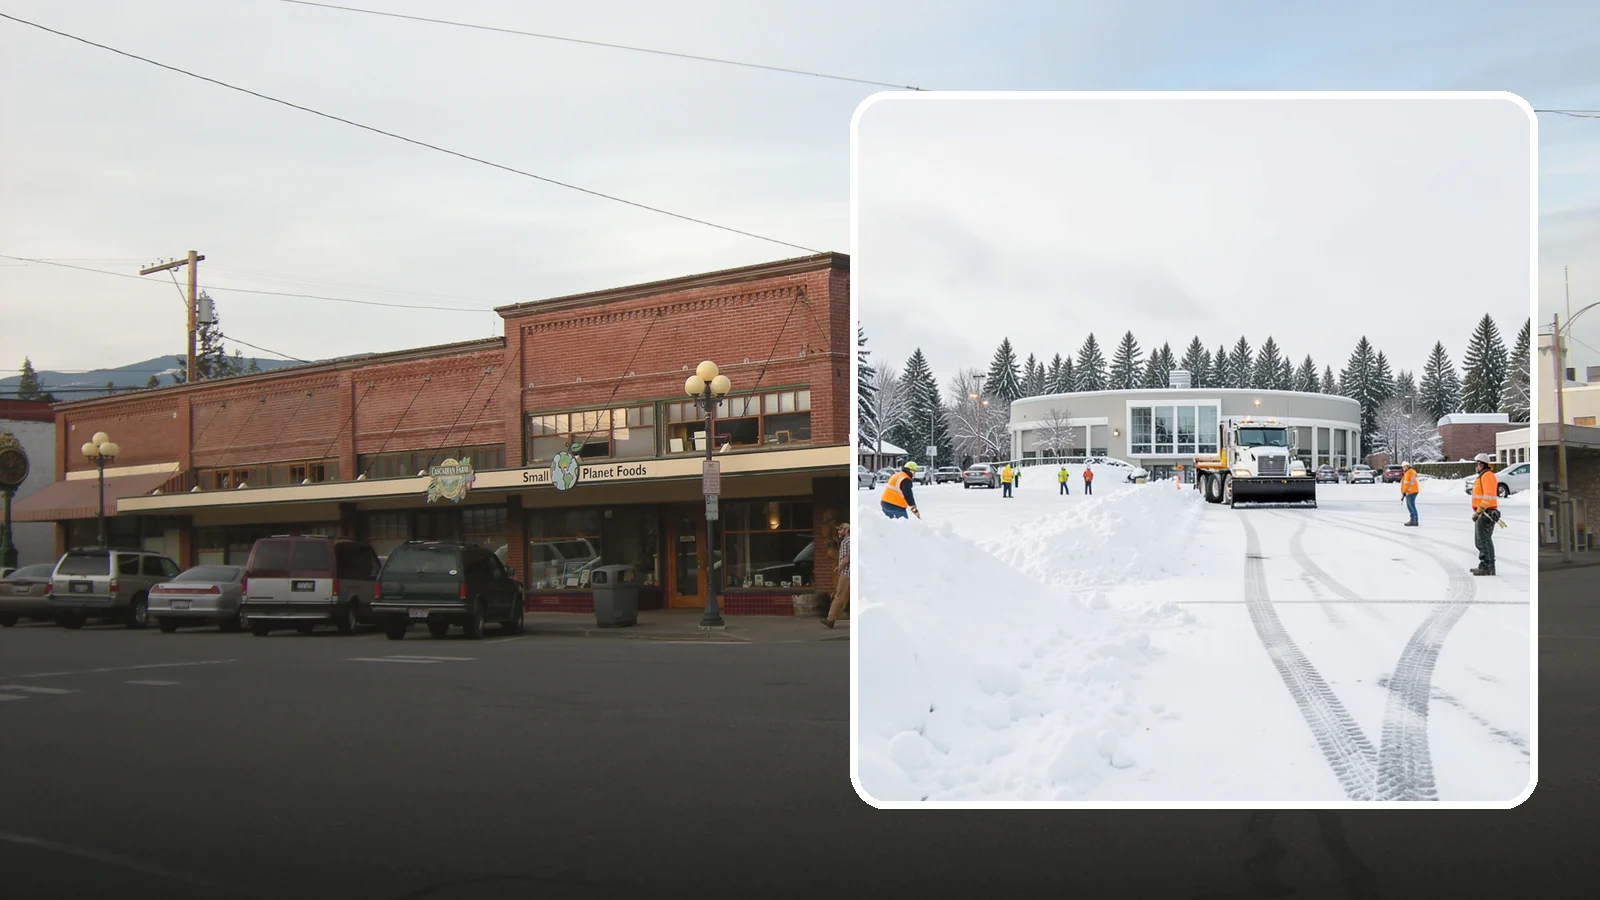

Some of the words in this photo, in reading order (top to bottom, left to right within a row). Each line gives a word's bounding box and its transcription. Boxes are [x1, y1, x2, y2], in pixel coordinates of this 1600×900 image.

[523, 471, 549, 483] Small
[583, 467, 614, 479] Planet
[617, 464, 647, 477] Foods
